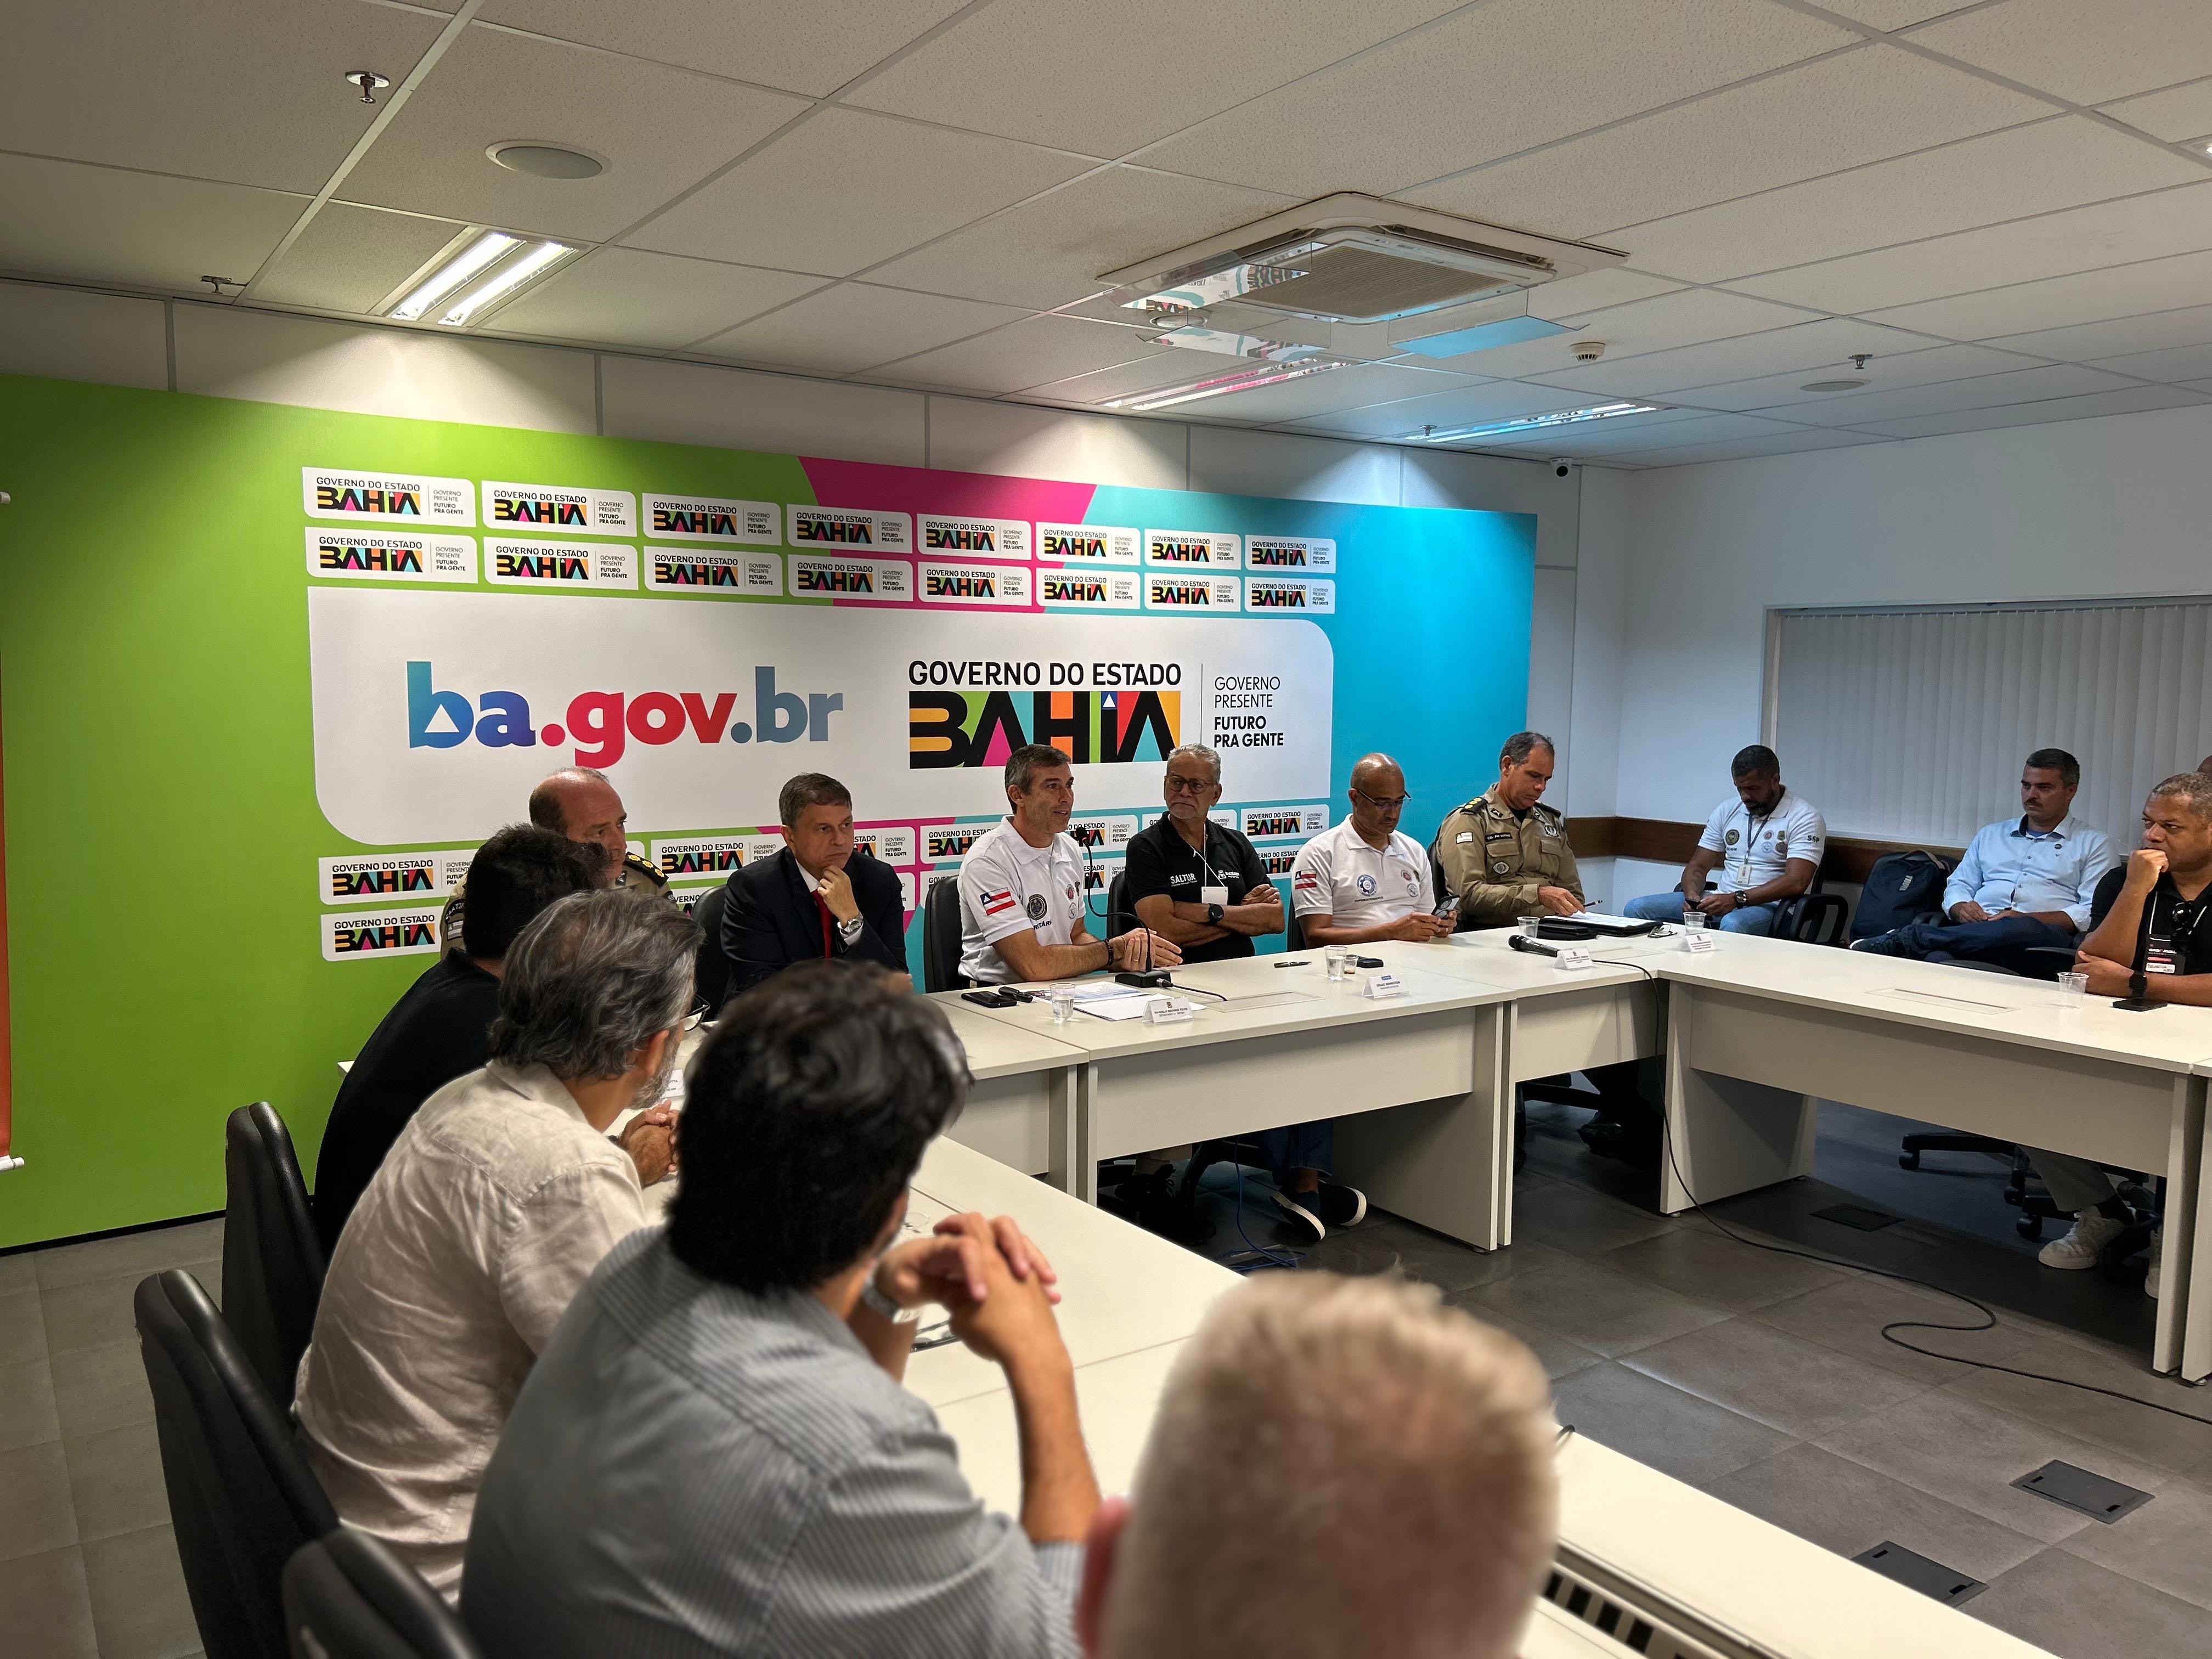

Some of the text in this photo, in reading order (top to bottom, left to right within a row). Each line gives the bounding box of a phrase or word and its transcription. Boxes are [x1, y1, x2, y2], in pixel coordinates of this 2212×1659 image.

[317, 477, 365, 487] GOVERNO
[385, 482, 420, 491] ESTADO
[494, 490, 537, 499] GOVERNO
[555, 494, 586, 503] ESTADO
[653, 501, 692, 510] GOVERNO
[708, 505, 736, 514] ESTADO
[797, 512, 831, 520] GOVERNO
[319, 537, 367, 546] GOVERNO
[387, 540, 422, 549] ESTADO
[496, 546, 539, 555] GOVERNO
[909, 660, 1181, 685] GOVERNO DO ESTADO
[1215, 676, 1280, 690] GOVERNO
[1215, 693, 1273, 708] PRESENTE
[407, 661, 843, 769] ba.gov.br
[1214, 715, 1266, 730] FUTURO
[909, 691, 1181, 769] BAHIA
[1214, 732, 1284, 748] PRA GENTE
[662, 845, 699, 853] GOVERNO
[332, 862, 379, 872] GOVERNO
[399, 860, 432, 868] ESTADO
[1170, 873, 1196, 884] SALTUR
[335, 918, 381, 929] GOVERNO
[400, 915, 434, 924] ESTADO
